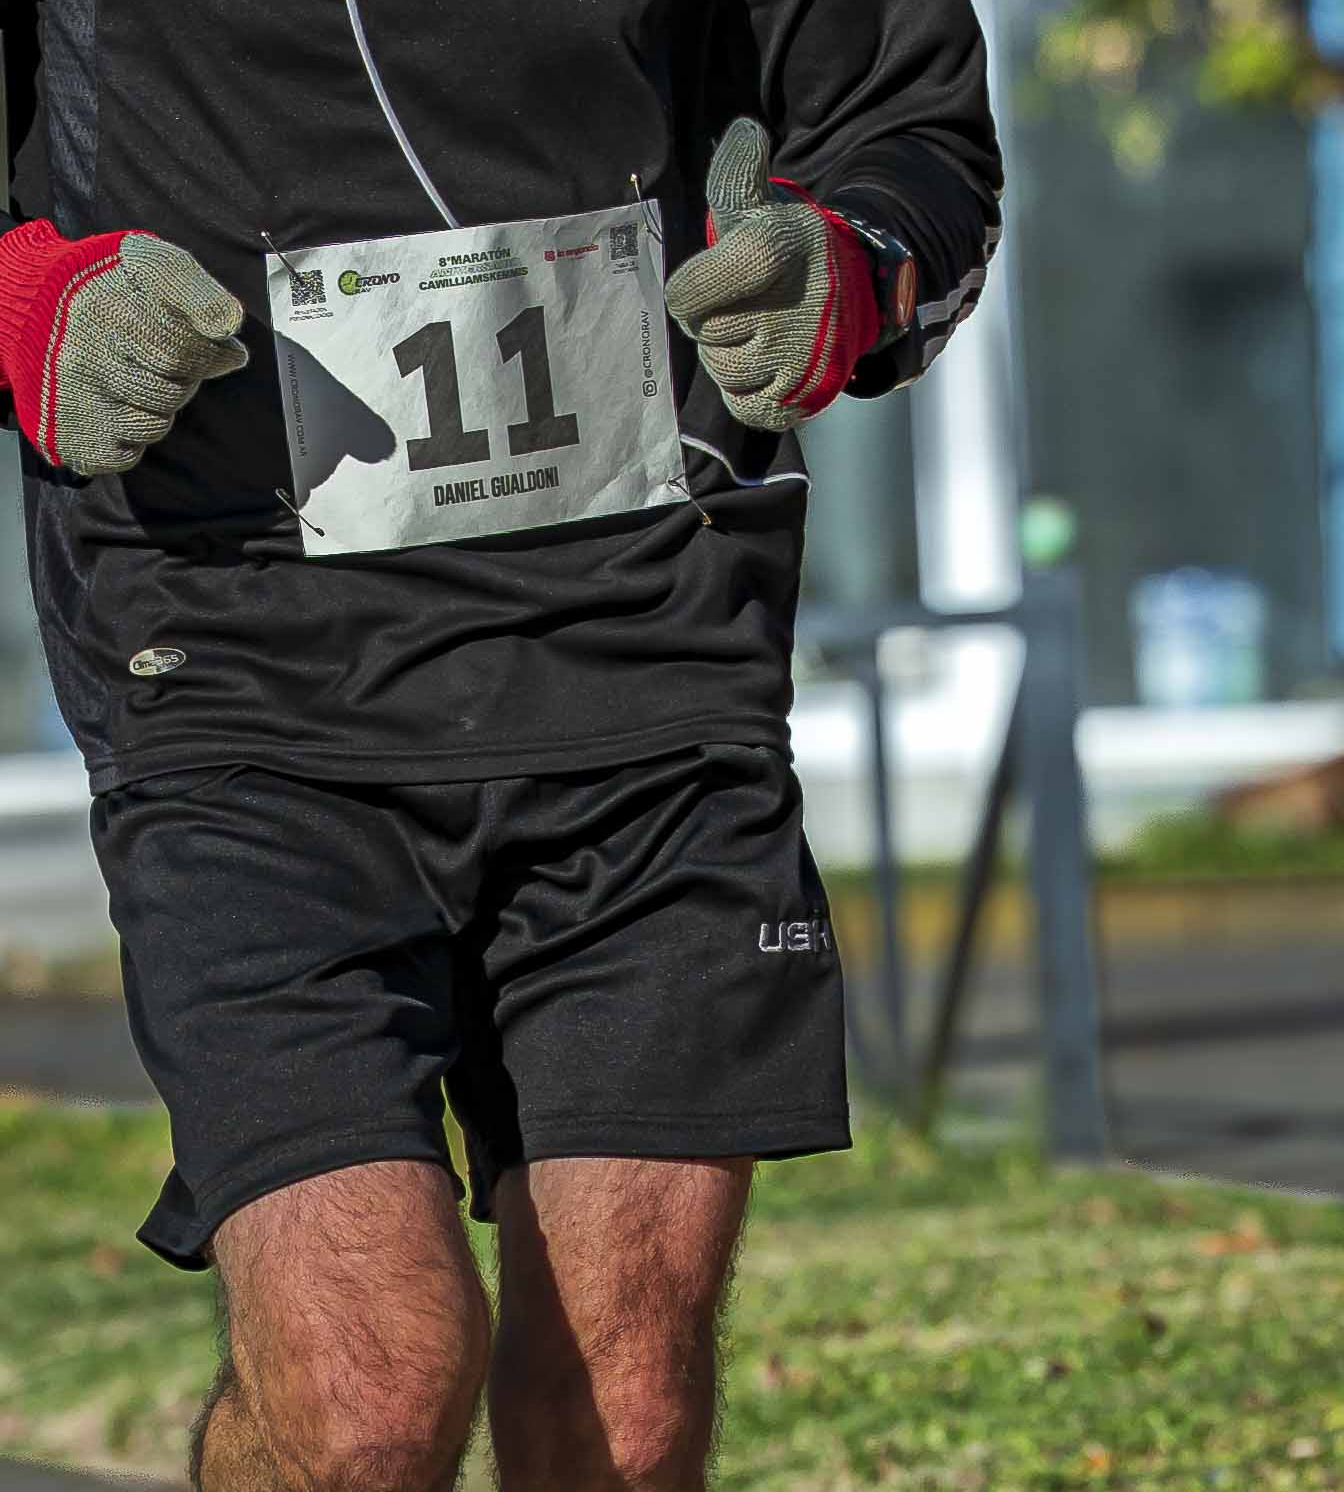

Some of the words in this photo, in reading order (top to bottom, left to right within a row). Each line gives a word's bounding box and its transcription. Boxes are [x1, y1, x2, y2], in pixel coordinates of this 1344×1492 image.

[640, 310, 654, 378] @CRONORAV
[392, 305, 580, 472] 11
[433, 478, 489, 507] DANIEL
[491, 465, 560, 498] GUALDONI
